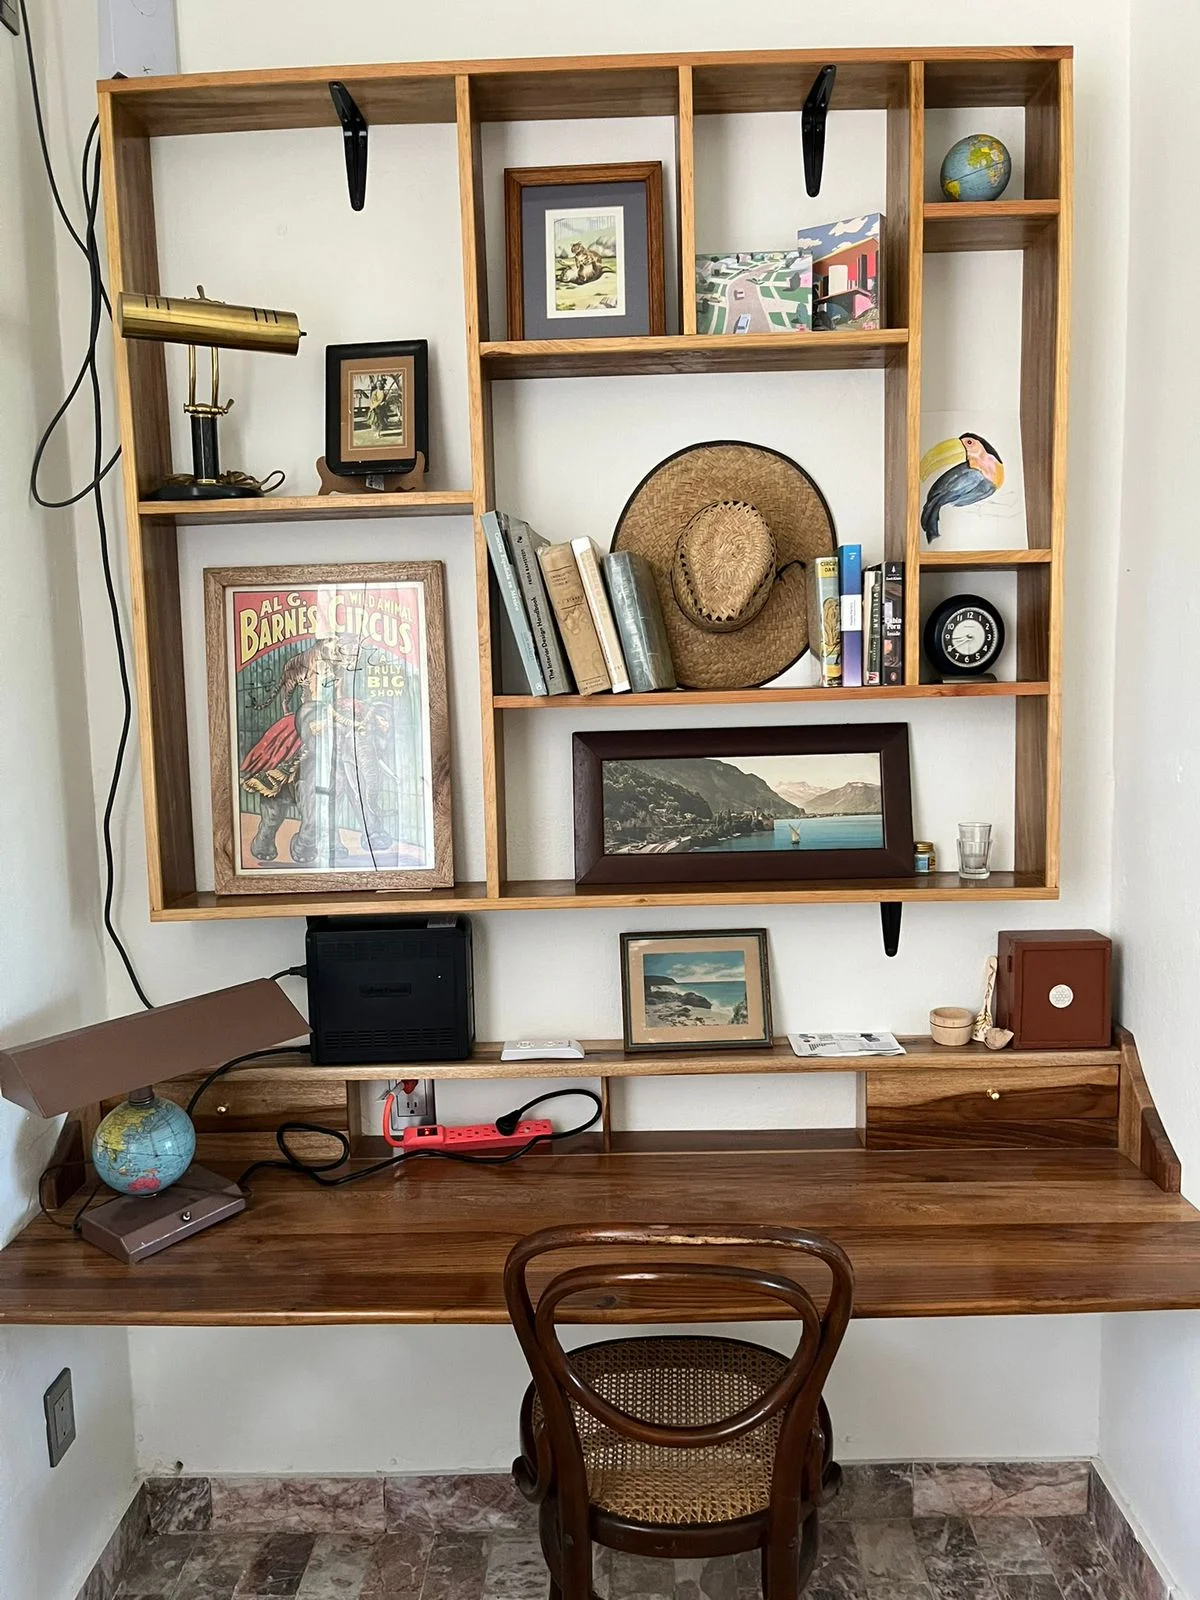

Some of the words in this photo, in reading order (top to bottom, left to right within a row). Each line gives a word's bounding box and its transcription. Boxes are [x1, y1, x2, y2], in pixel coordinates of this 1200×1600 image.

[259, 596, 283, 617] AL
[286, 592, 307, 607] G.
[376, 597, 413, 622] ANIMAL
[530, 596, 543, 628] Handbook
[239, 605, 318, 664] BARNES
[328, 594, 413, 655] CIRCUS
[540, 627, 548, 648] Design
[379, 654, 387, 663] A
[367, 664, 402, 675] TRULY
[367, 675, 405, 688] BIG
[370, 689, 403, 698] SHOW
